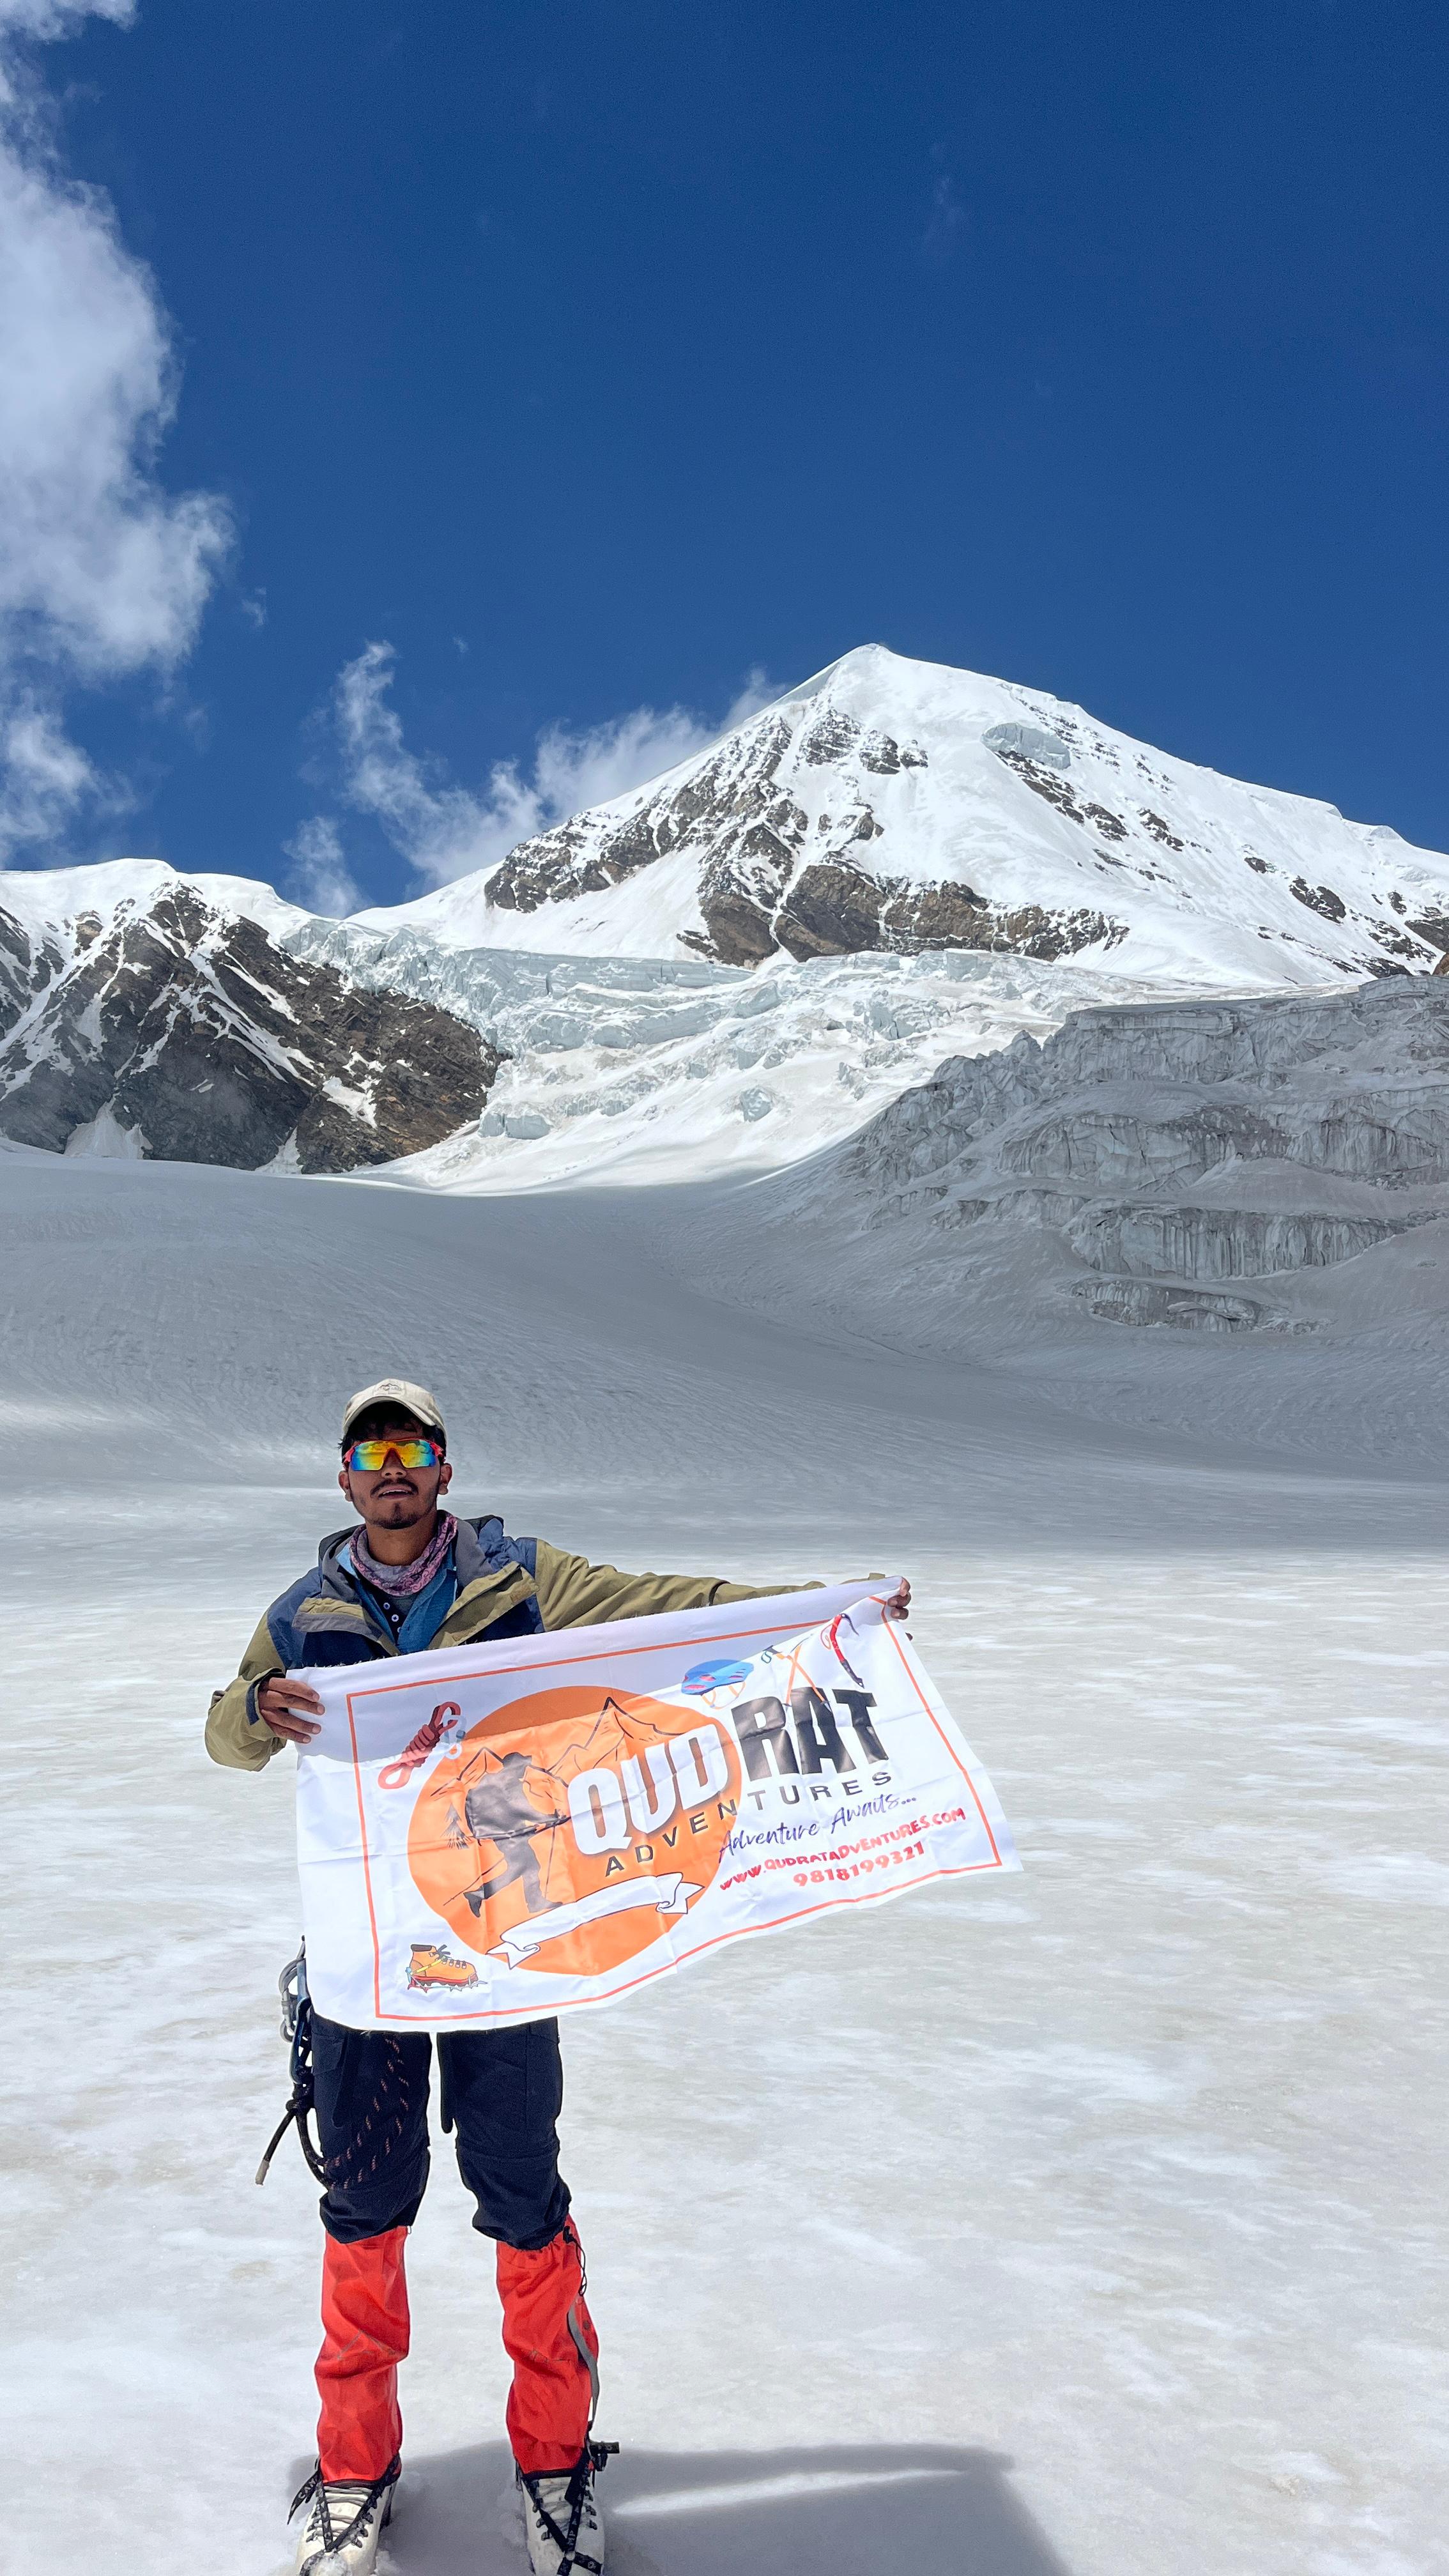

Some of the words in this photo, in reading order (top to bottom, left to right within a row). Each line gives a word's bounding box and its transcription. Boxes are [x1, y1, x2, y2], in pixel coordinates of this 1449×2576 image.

[604, 1771, 893, 1877] ADVENTURES
[718, 1822, 820, 1864] Adventure
[793, 1841, 924, 1886] 9818199321
